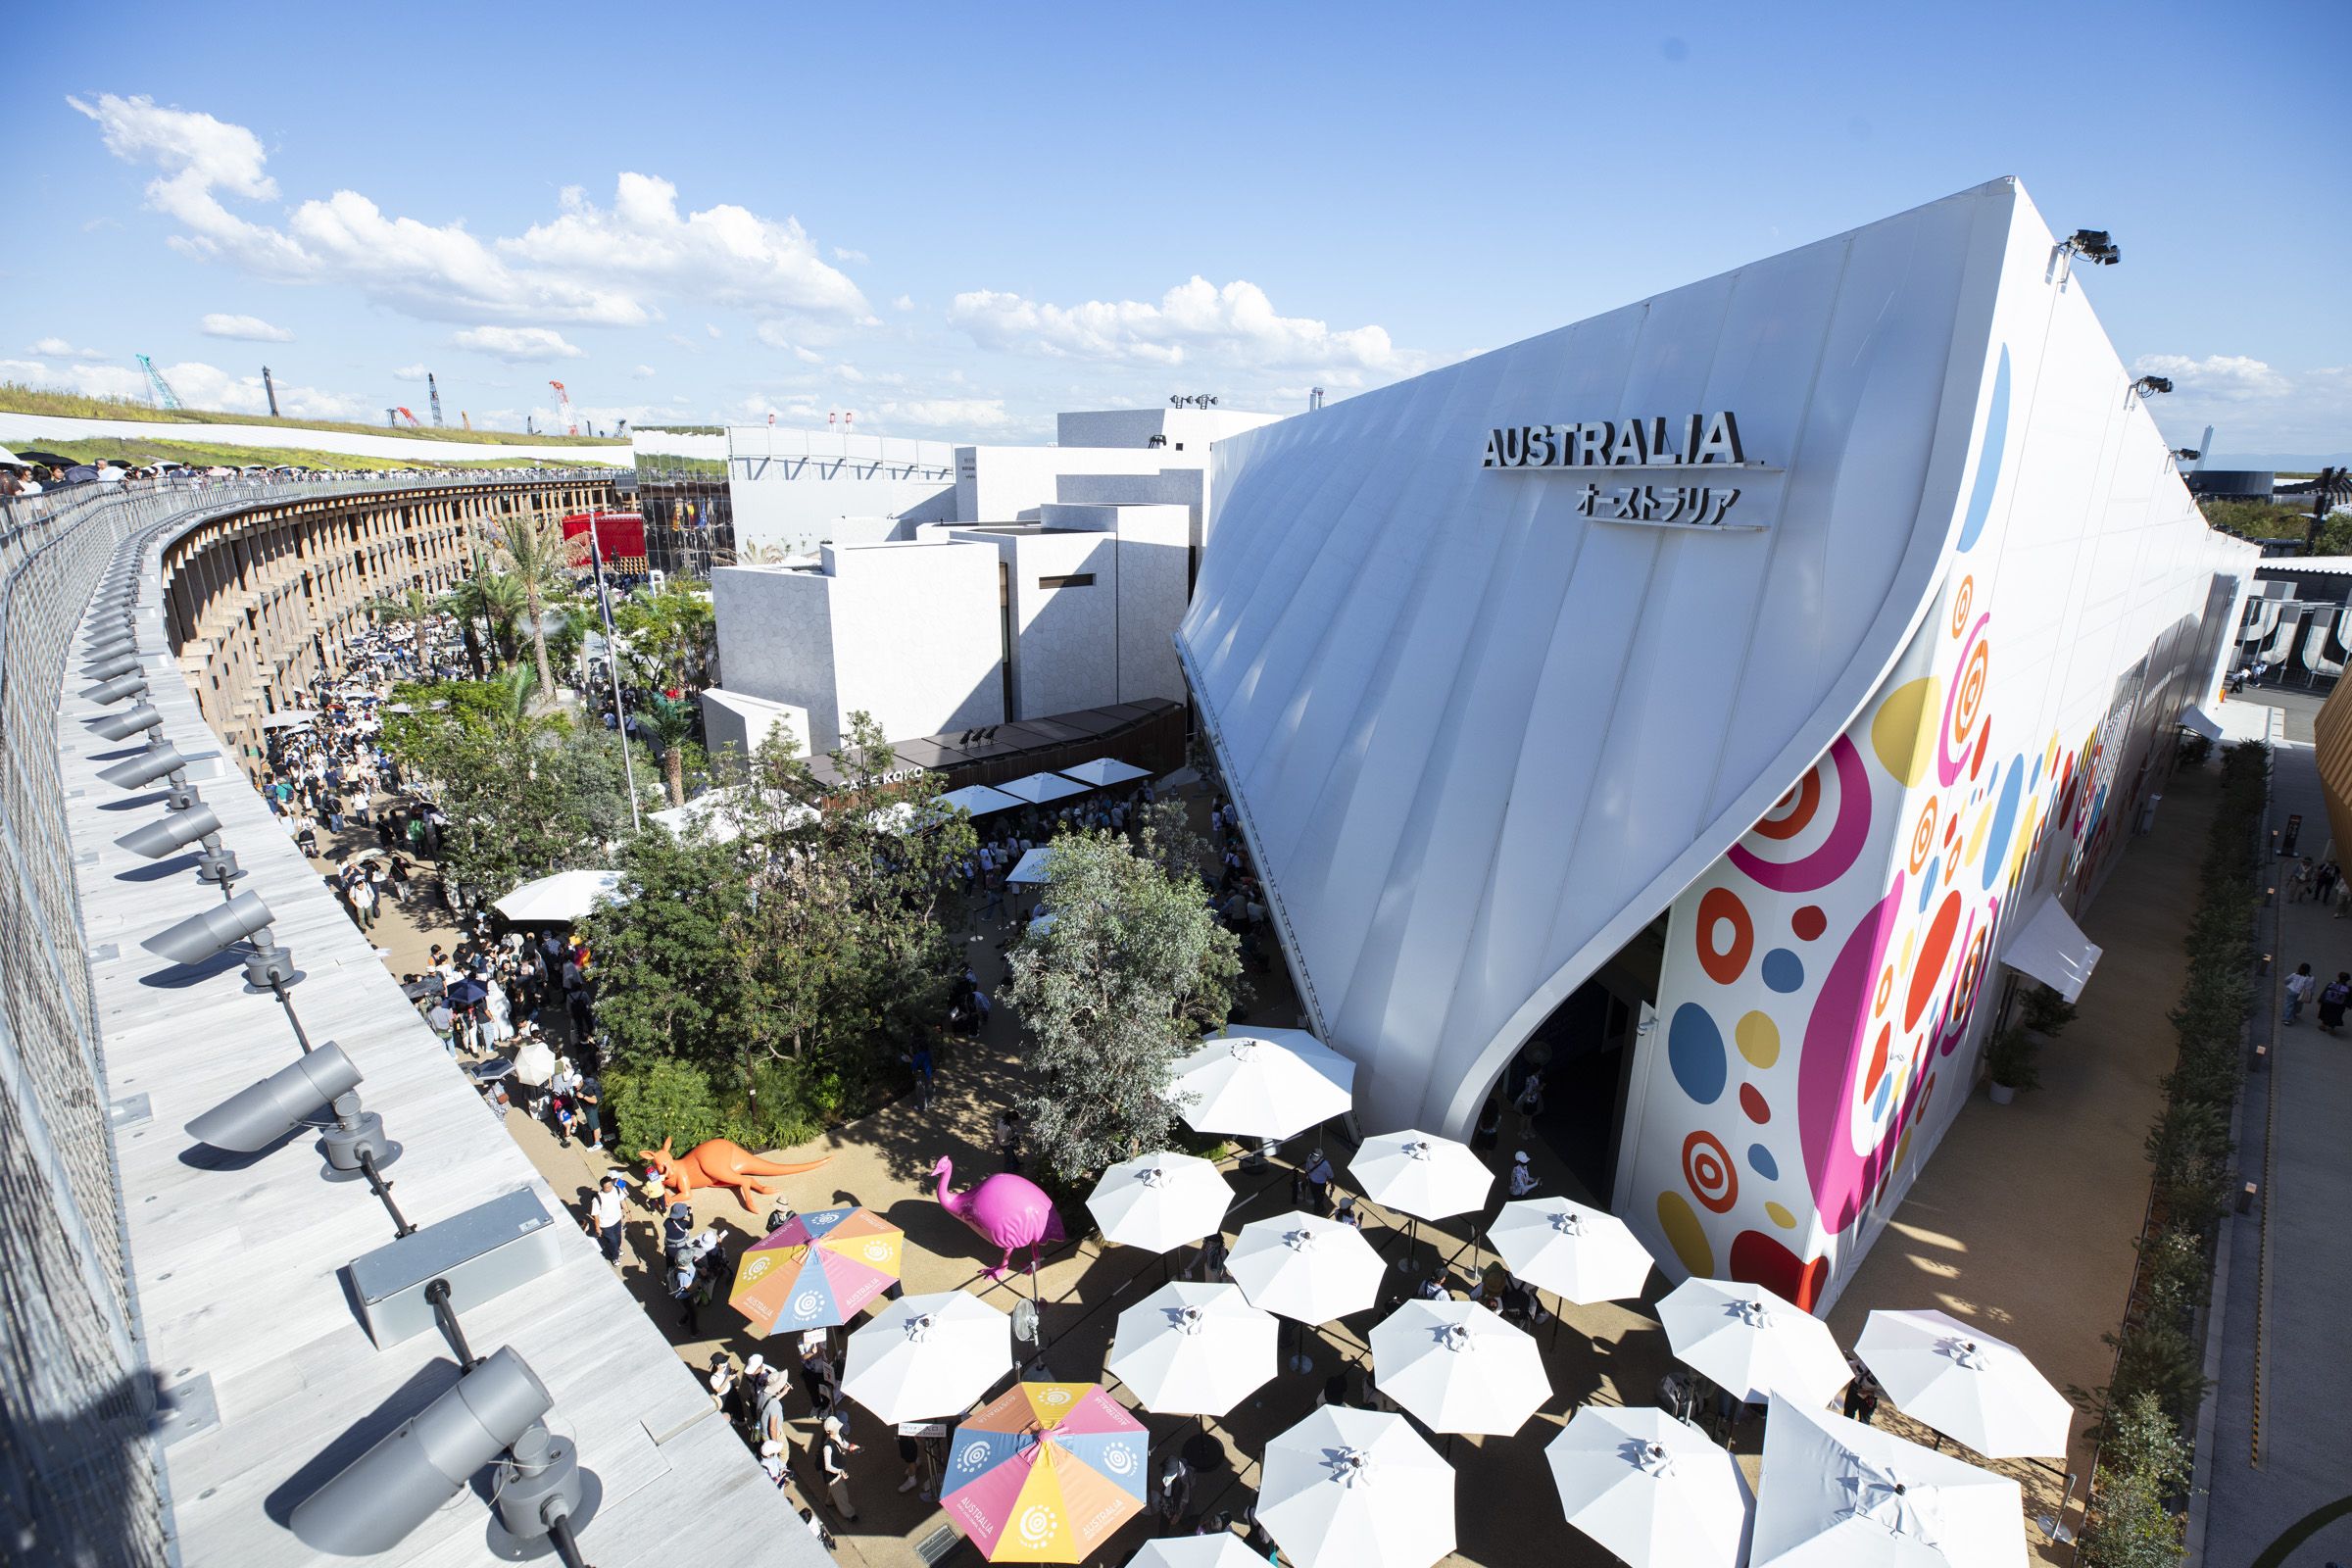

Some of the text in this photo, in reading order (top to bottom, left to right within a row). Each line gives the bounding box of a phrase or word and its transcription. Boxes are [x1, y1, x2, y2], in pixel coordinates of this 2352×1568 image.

[1482, 412, 1742, 466] AUSTRALIA
[1575, 484, 1740, 525] オーストラリア
[883, 766, 923, 784] KOKO
[846, 1278, 879, 1305] AUSTRALIA
[960, 1497, 994, 1534] AUSTRALIA
[1082, 1499, 1123, 1536] AUSTRALIA
